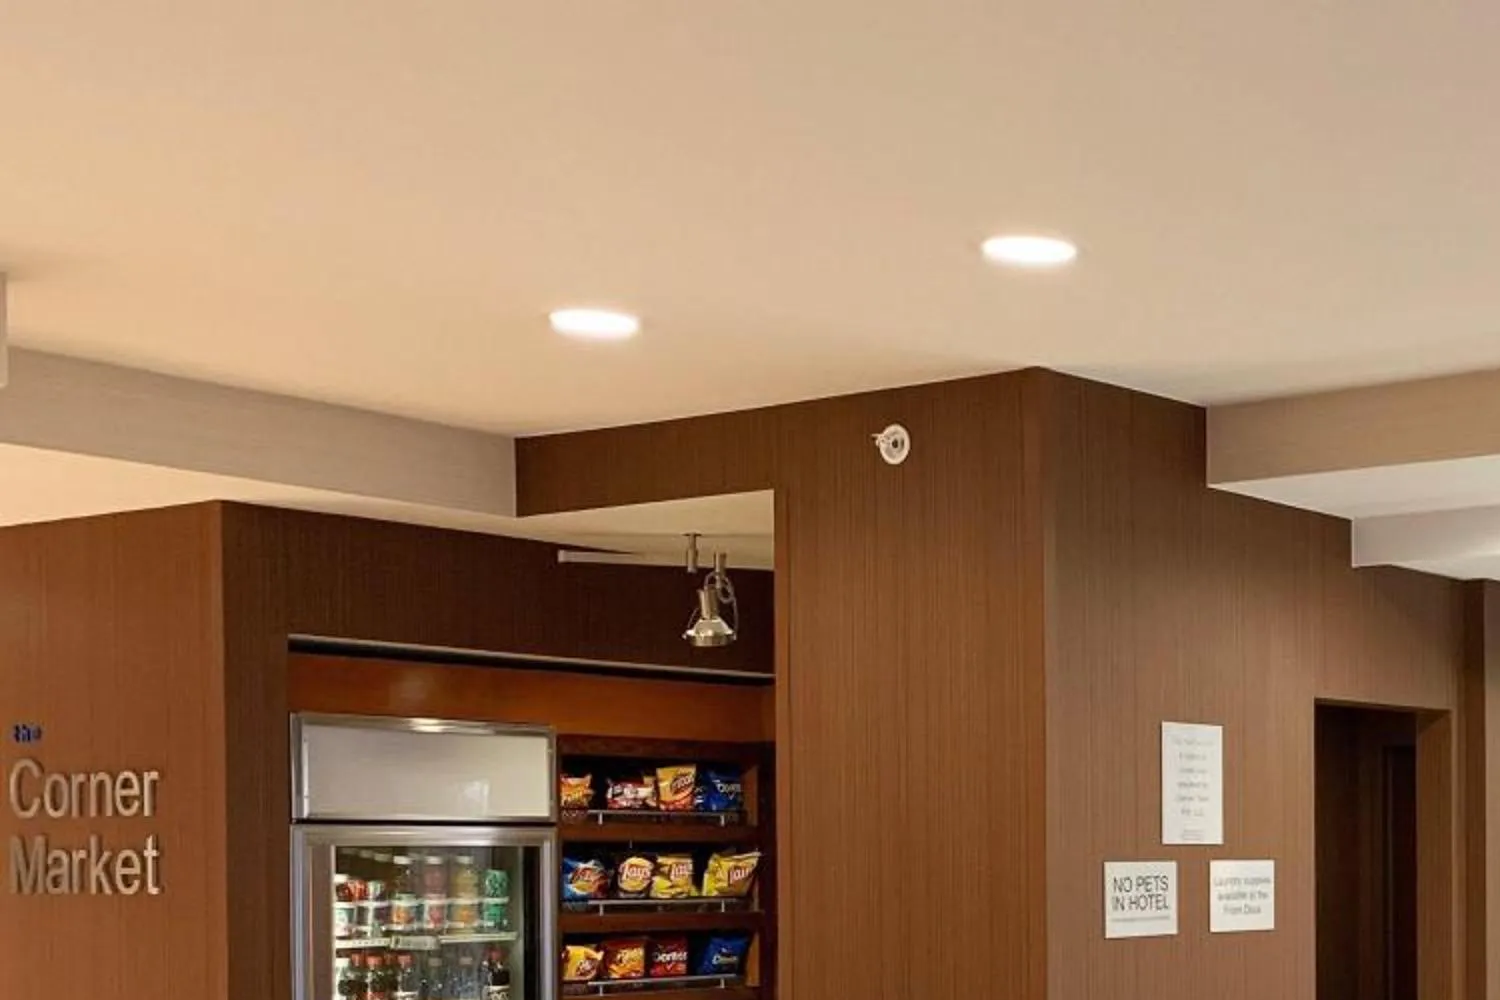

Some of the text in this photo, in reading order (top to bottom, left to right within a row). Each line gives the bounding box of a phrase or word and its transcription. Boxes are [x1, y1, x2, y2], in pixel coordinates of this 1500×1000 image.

[9, 758, 159, 819] Corner
[10, 834, 160, 896] Market
[1113, 874, 1169, 893] NO PETS
[1111, 893, 1169, 912] IN HOTEL
